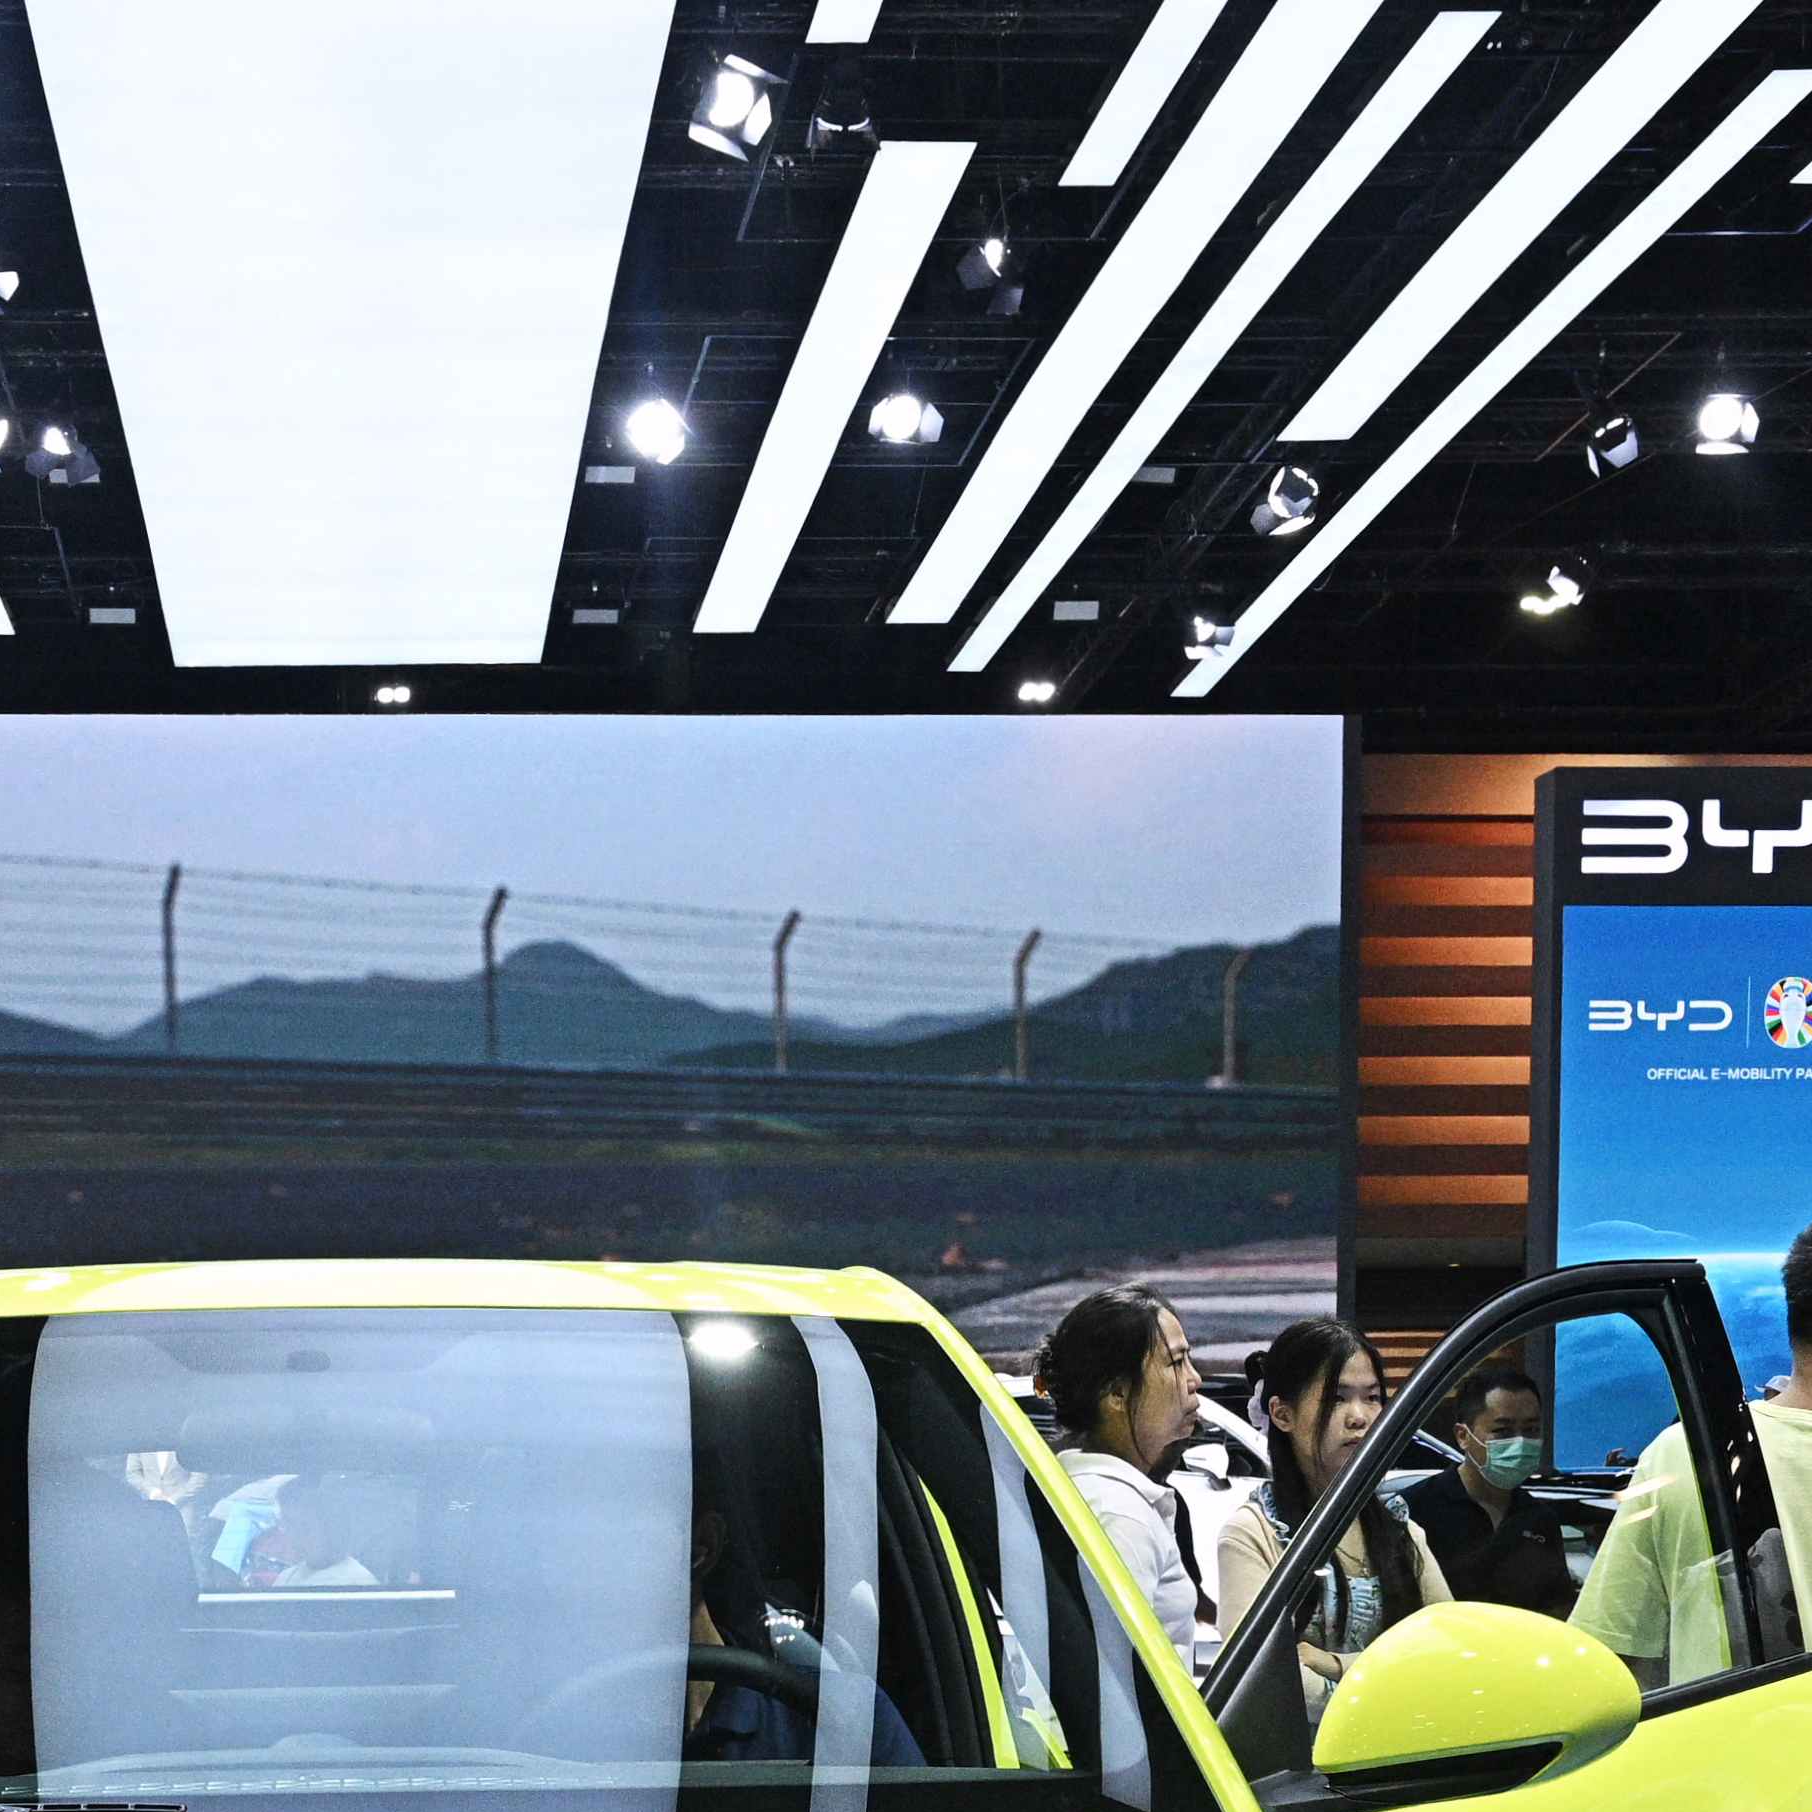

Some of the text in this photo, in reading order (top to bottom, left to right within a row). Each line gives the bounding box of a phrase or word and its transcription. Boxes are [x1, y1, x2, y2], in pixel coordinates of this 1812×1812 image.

[1588, 1000, 1733, 1031] BYD
[1647, 1068, 1708, 1080] OFFICIAL
[1711, 1068, 1792, 1080] E-MOBILITY
